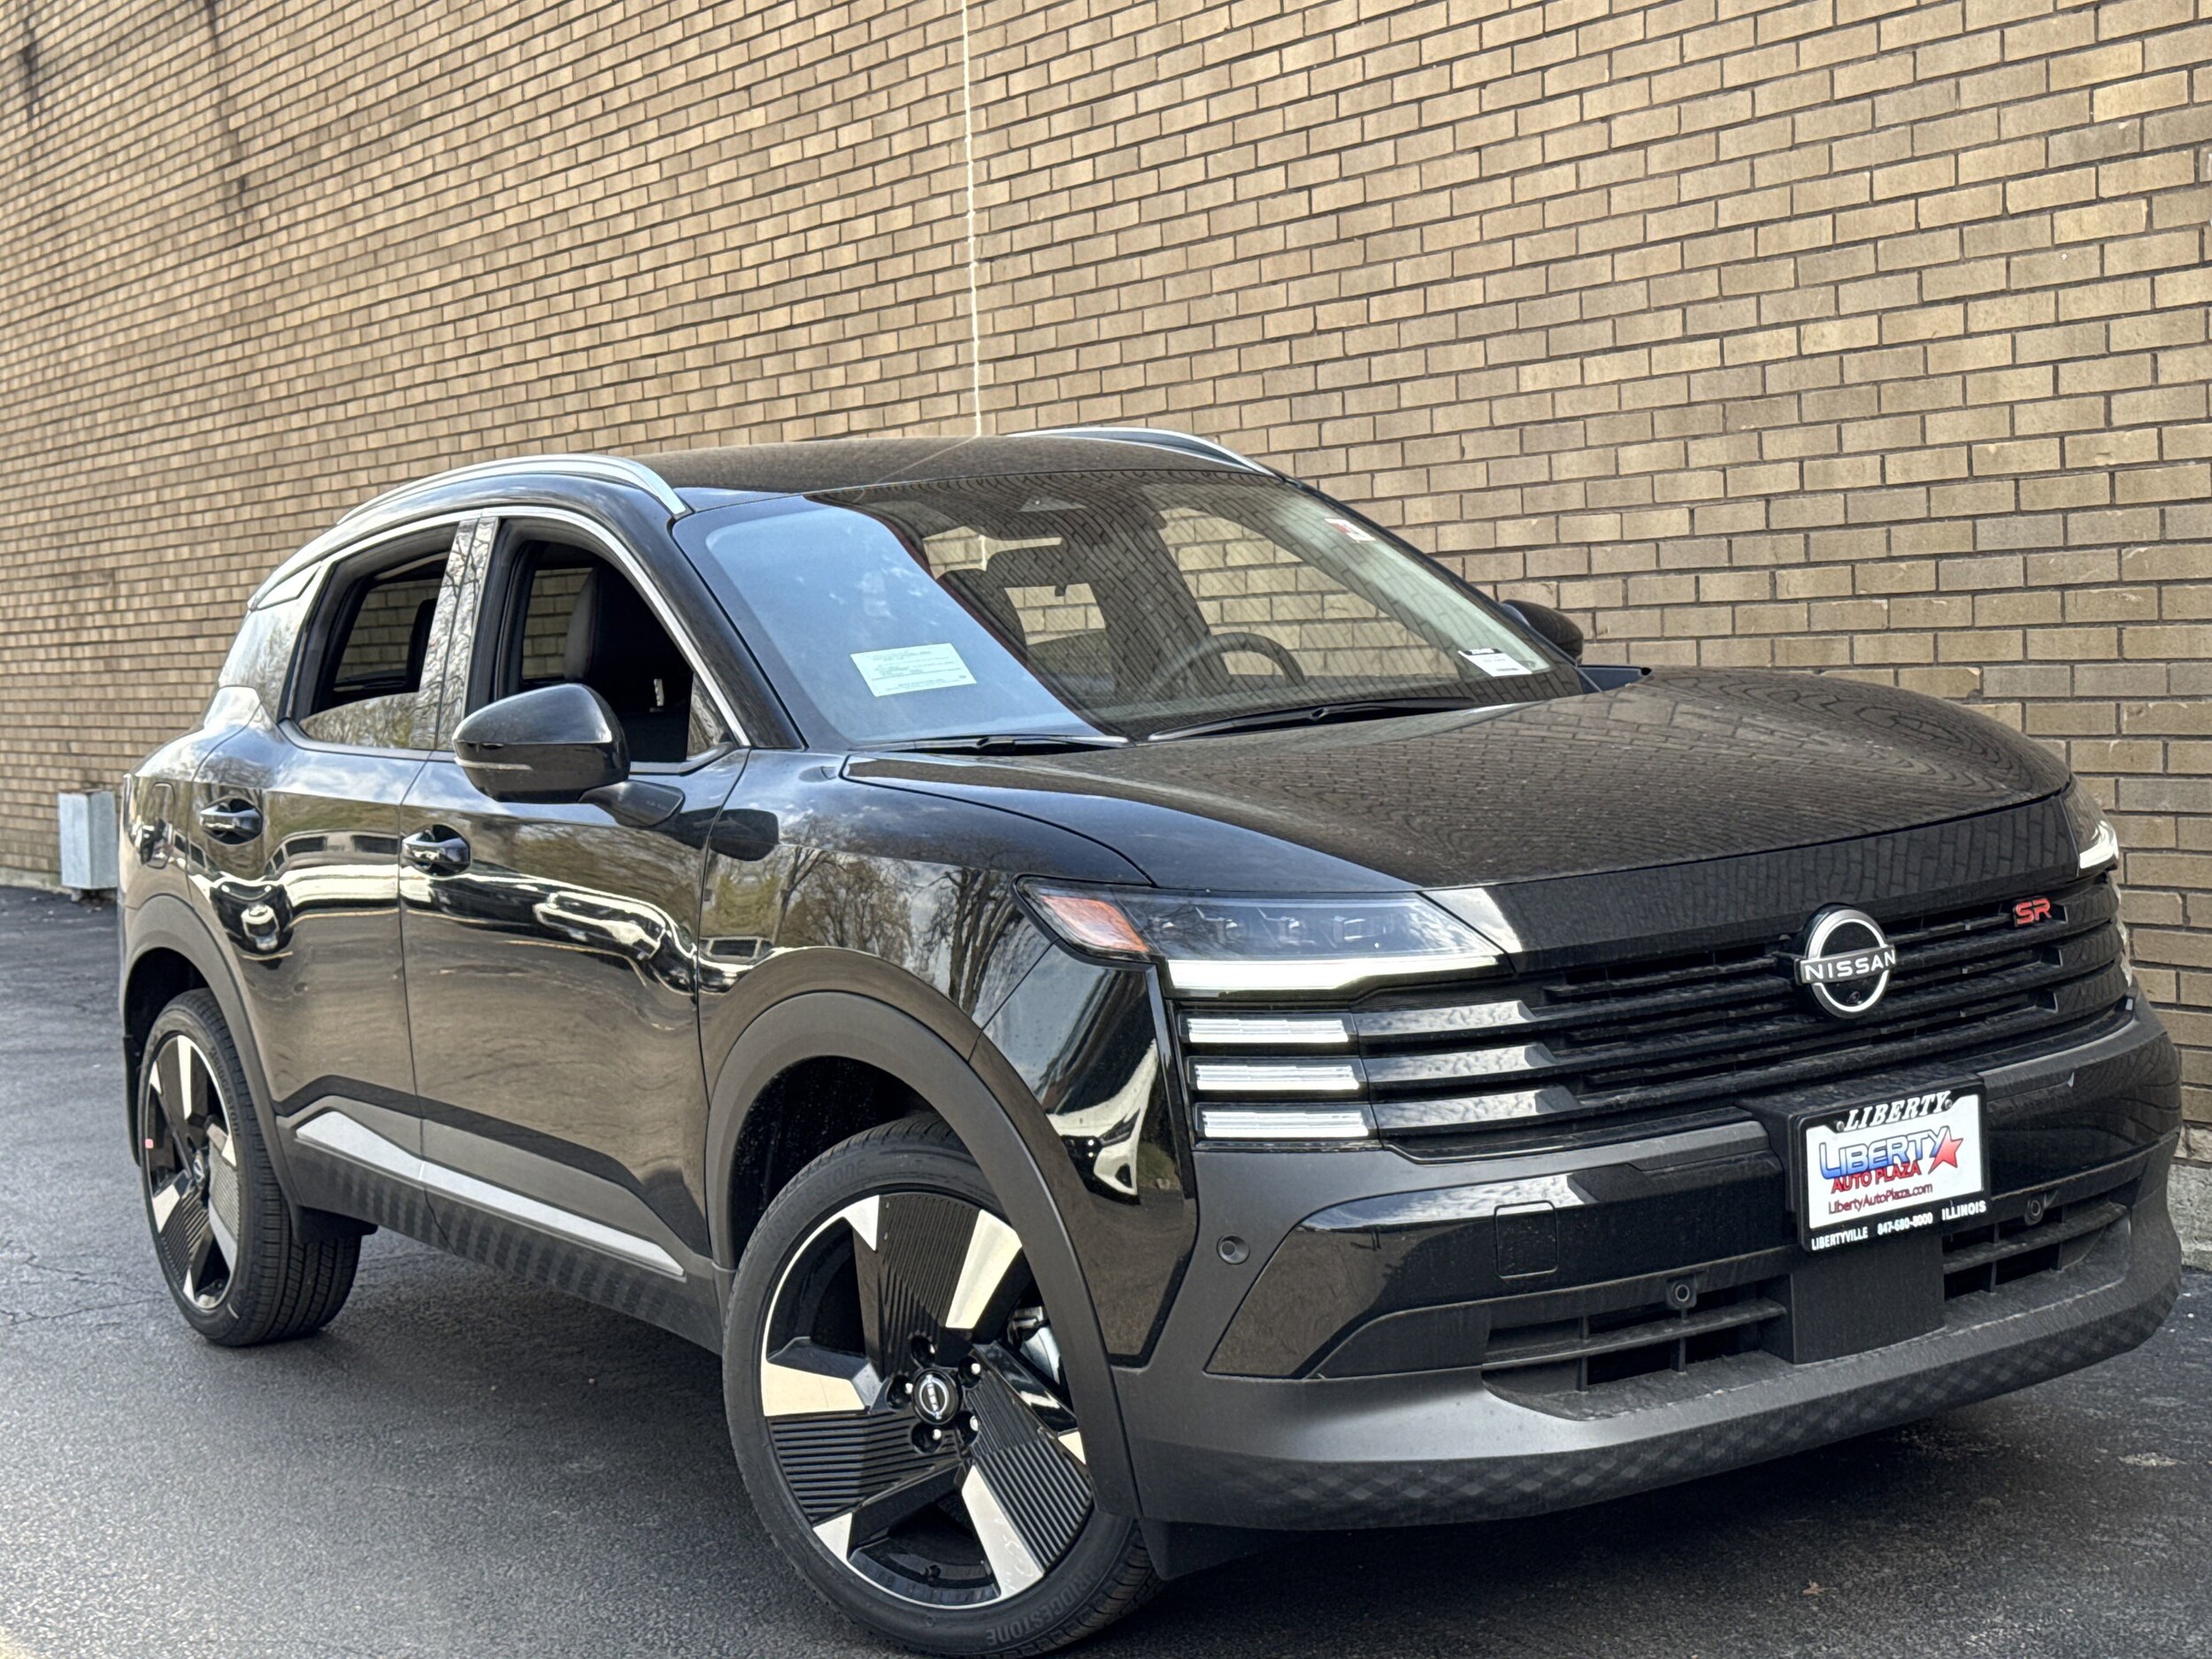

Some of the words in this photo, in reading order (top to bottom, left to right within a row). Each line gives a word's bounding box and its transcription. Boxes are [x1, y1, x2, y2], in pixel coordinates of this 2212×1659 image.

[2016, 896, 2052, 925] SR
[1804, 949, 1896, 981] NISSAN
[1843, 1090, 1952, 1132] LIBERTY
[1819, 1125, 1950, 1179] LIBERTY
[1831, 1170, 1872, 1194] AUTO
[1875, 1160, 1922, 1185] PLAZA
[1828, 1184, 1933, 1214] LibertyAutoPlaza.com
[1811, 1226, 1869, 1250] LIBERTYVILLE
[1941, 1201, 1986, 1220] ILLINOIS
